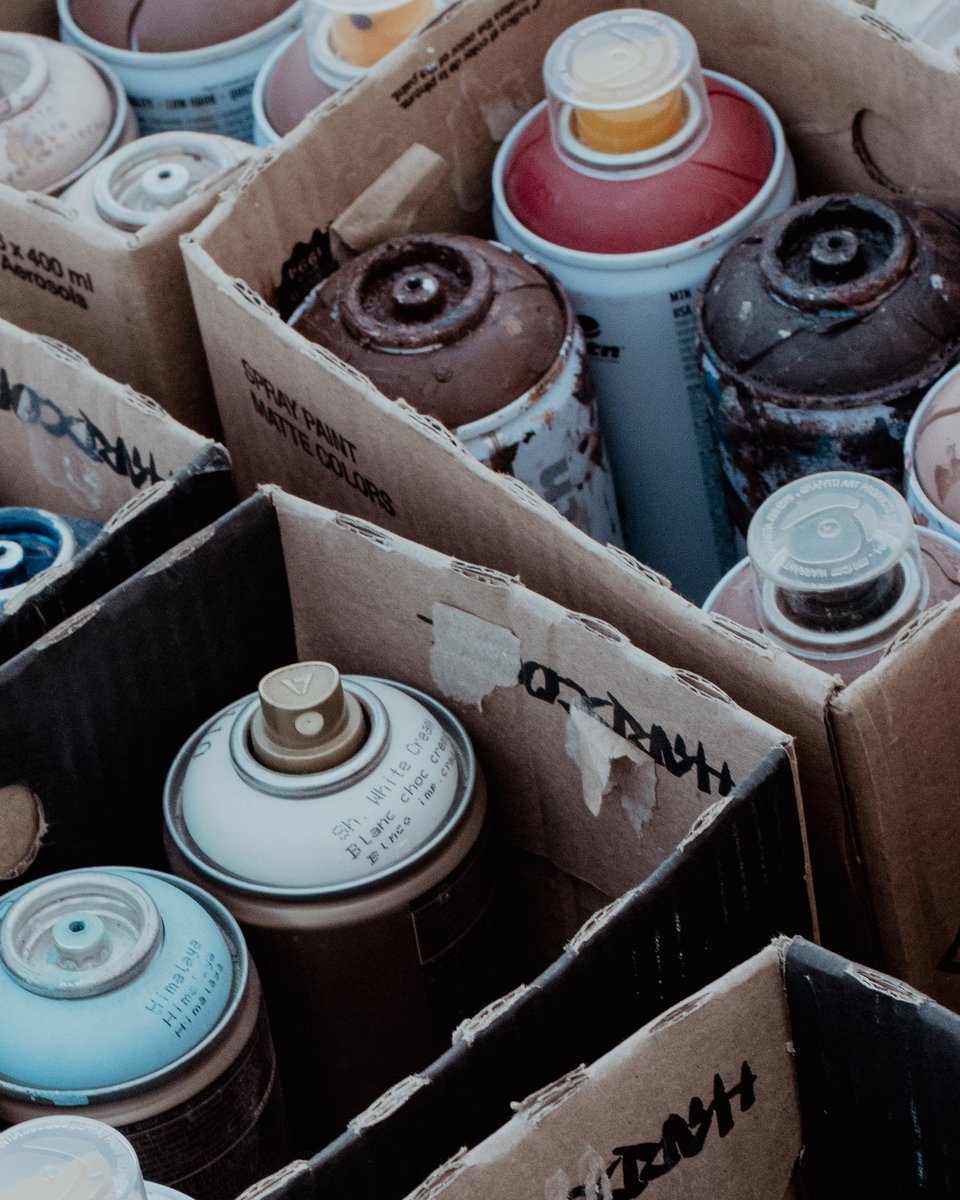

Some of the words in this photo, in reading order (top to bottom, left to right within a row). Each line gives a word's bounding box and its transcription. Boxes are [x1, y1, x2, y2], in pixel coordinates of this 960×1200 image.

[1, 258, 89, 311] Aerosols
[10, 241, 24, 262] x
[26, 247, 67, 282] 400
[67, 263, 95, 293] ml
[585, 341, 621, 359] tn
[240, 358, 303, 424] SPRAY
[304, 407, 358, 465] PAINT
[251, 390, 316, 458] MATTE
[314, 440, 397, 518] COLORS
[343, 806, 396, 860] Blanc
[395, 767, 429, 803] choc
[364, 757, 411, 805] White
[144, 938, 202, 1015] Himalaya
[174, 962, 223, 1038] Himalaya
